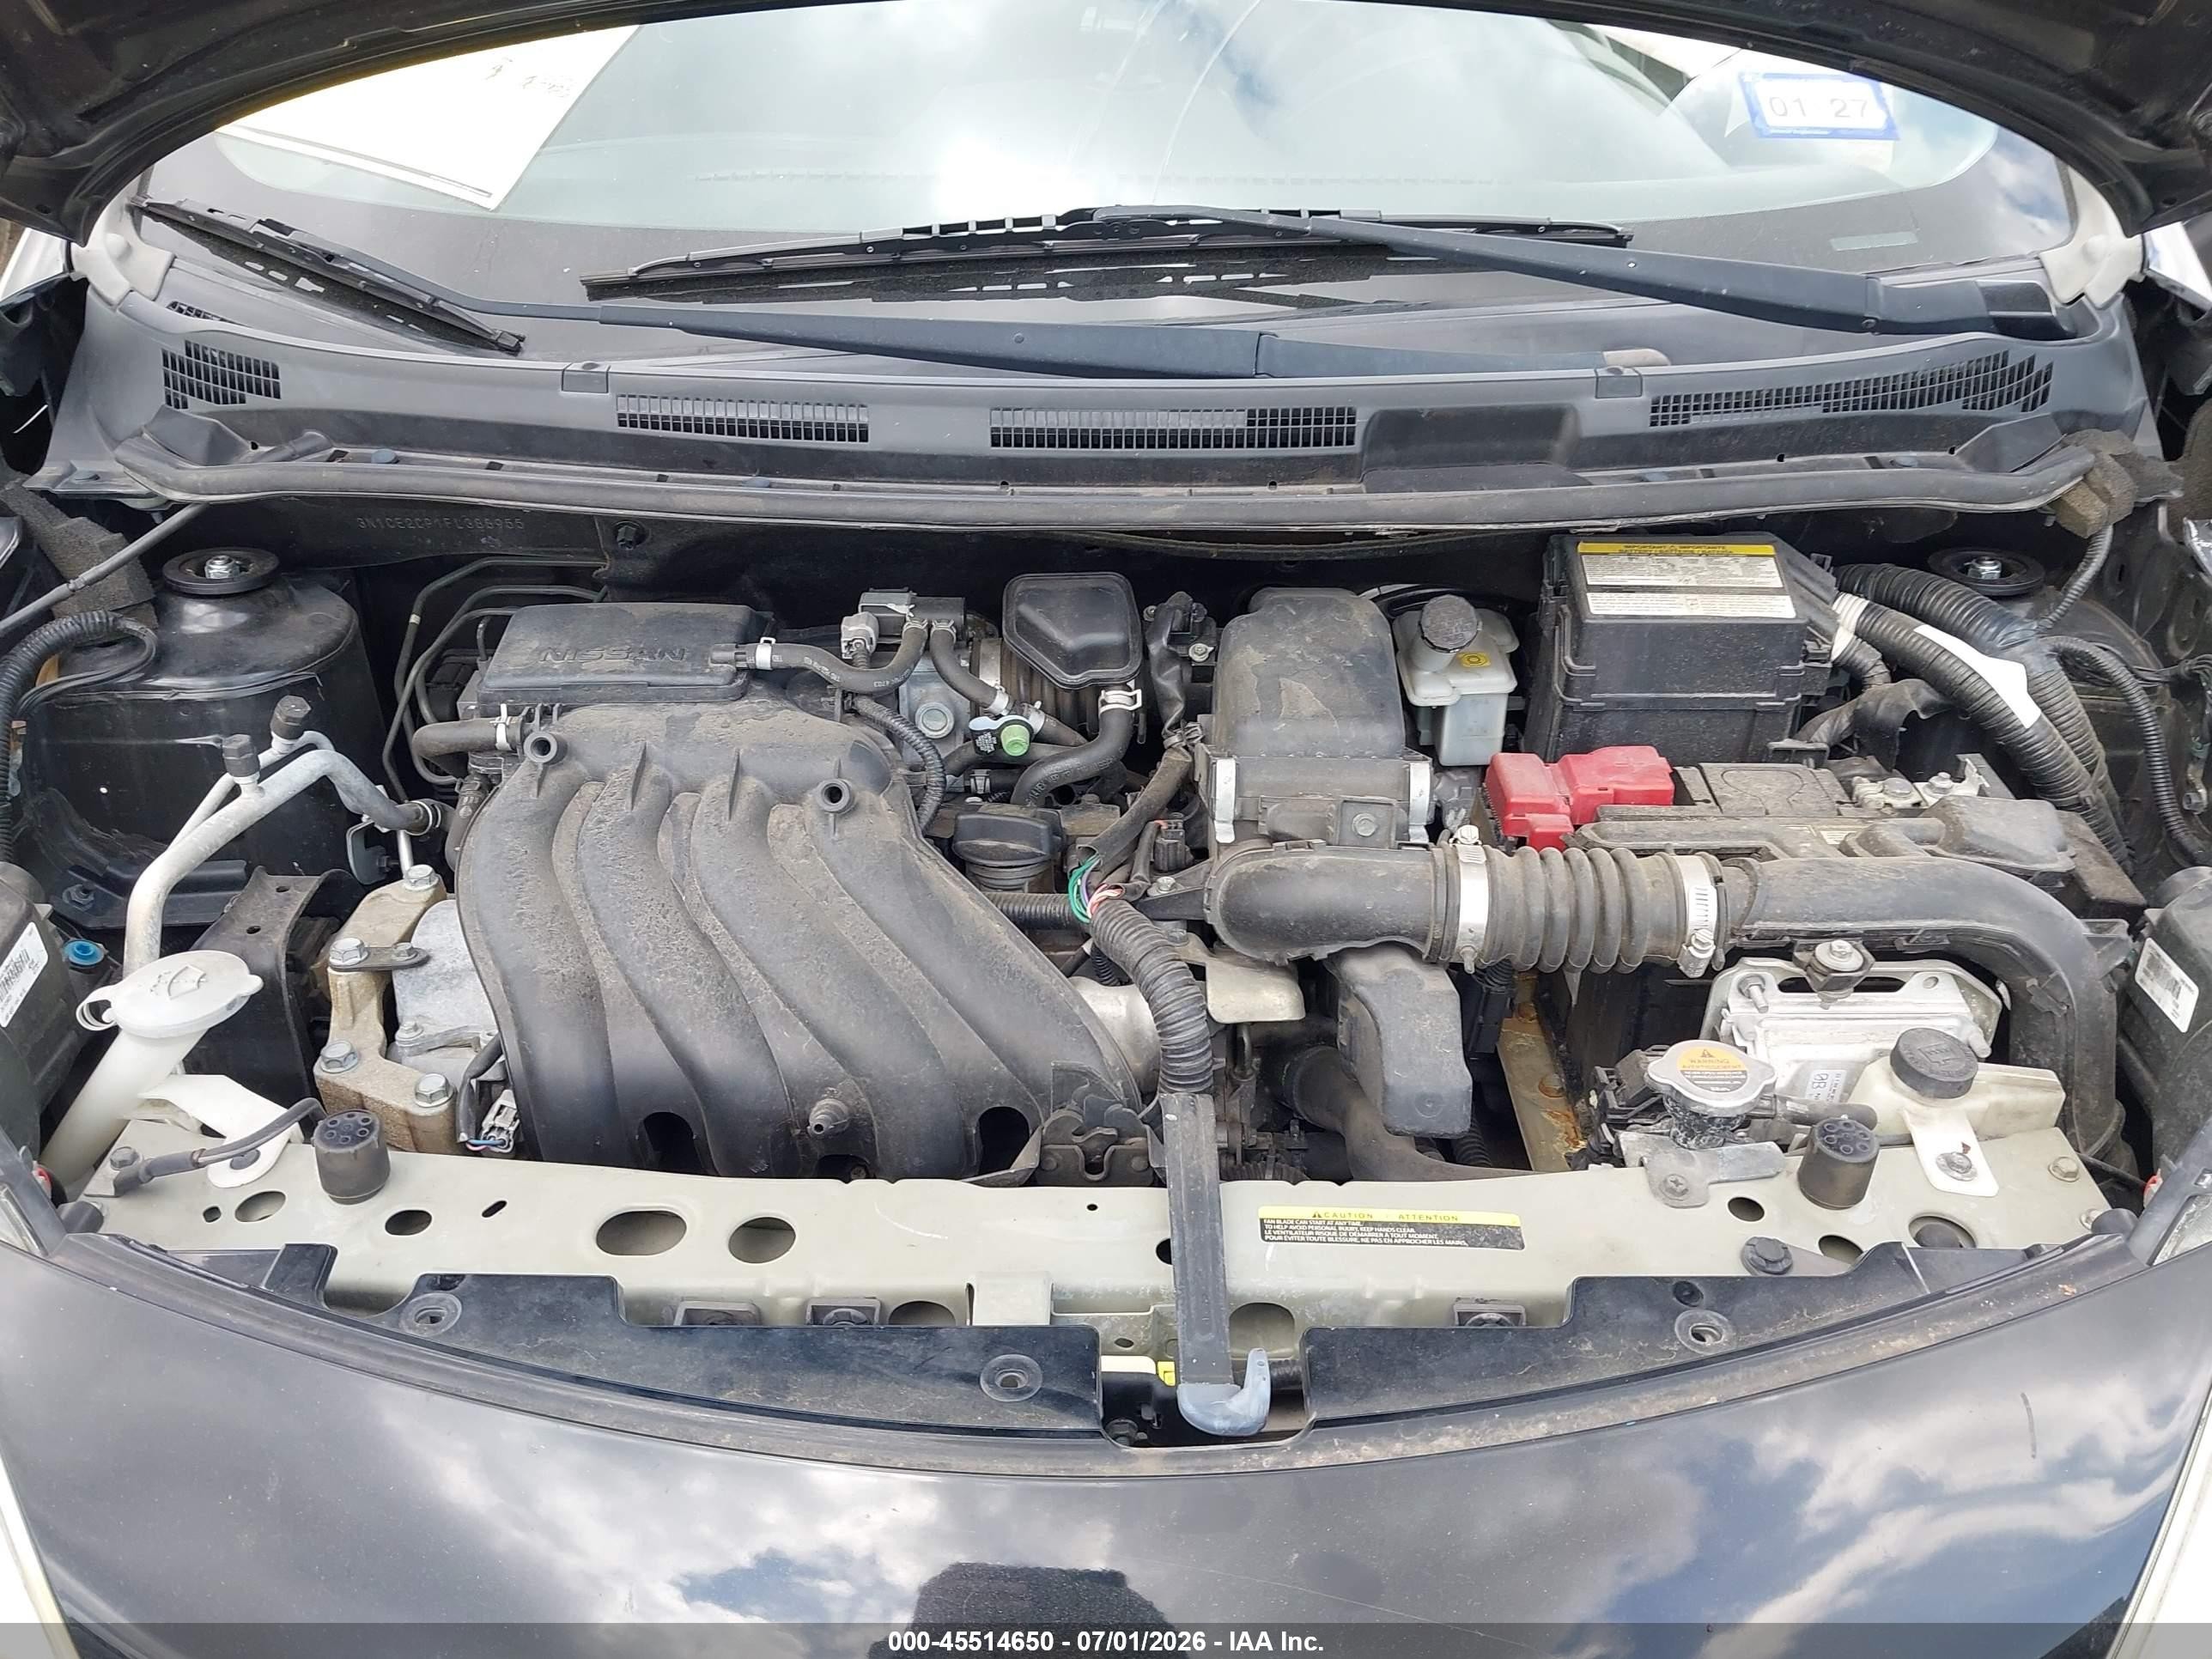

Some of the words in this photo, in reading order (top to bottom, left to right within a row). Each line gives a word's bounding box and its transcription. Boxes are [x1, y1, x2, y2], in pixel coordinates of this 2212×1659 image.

[1769, 96, 1807, 117] 01
[1830, 98, 1868, 118] 27
[539, 646, 687, 662] NISSAN
[1398, 1213, 1458, 1222] ATTENTION
